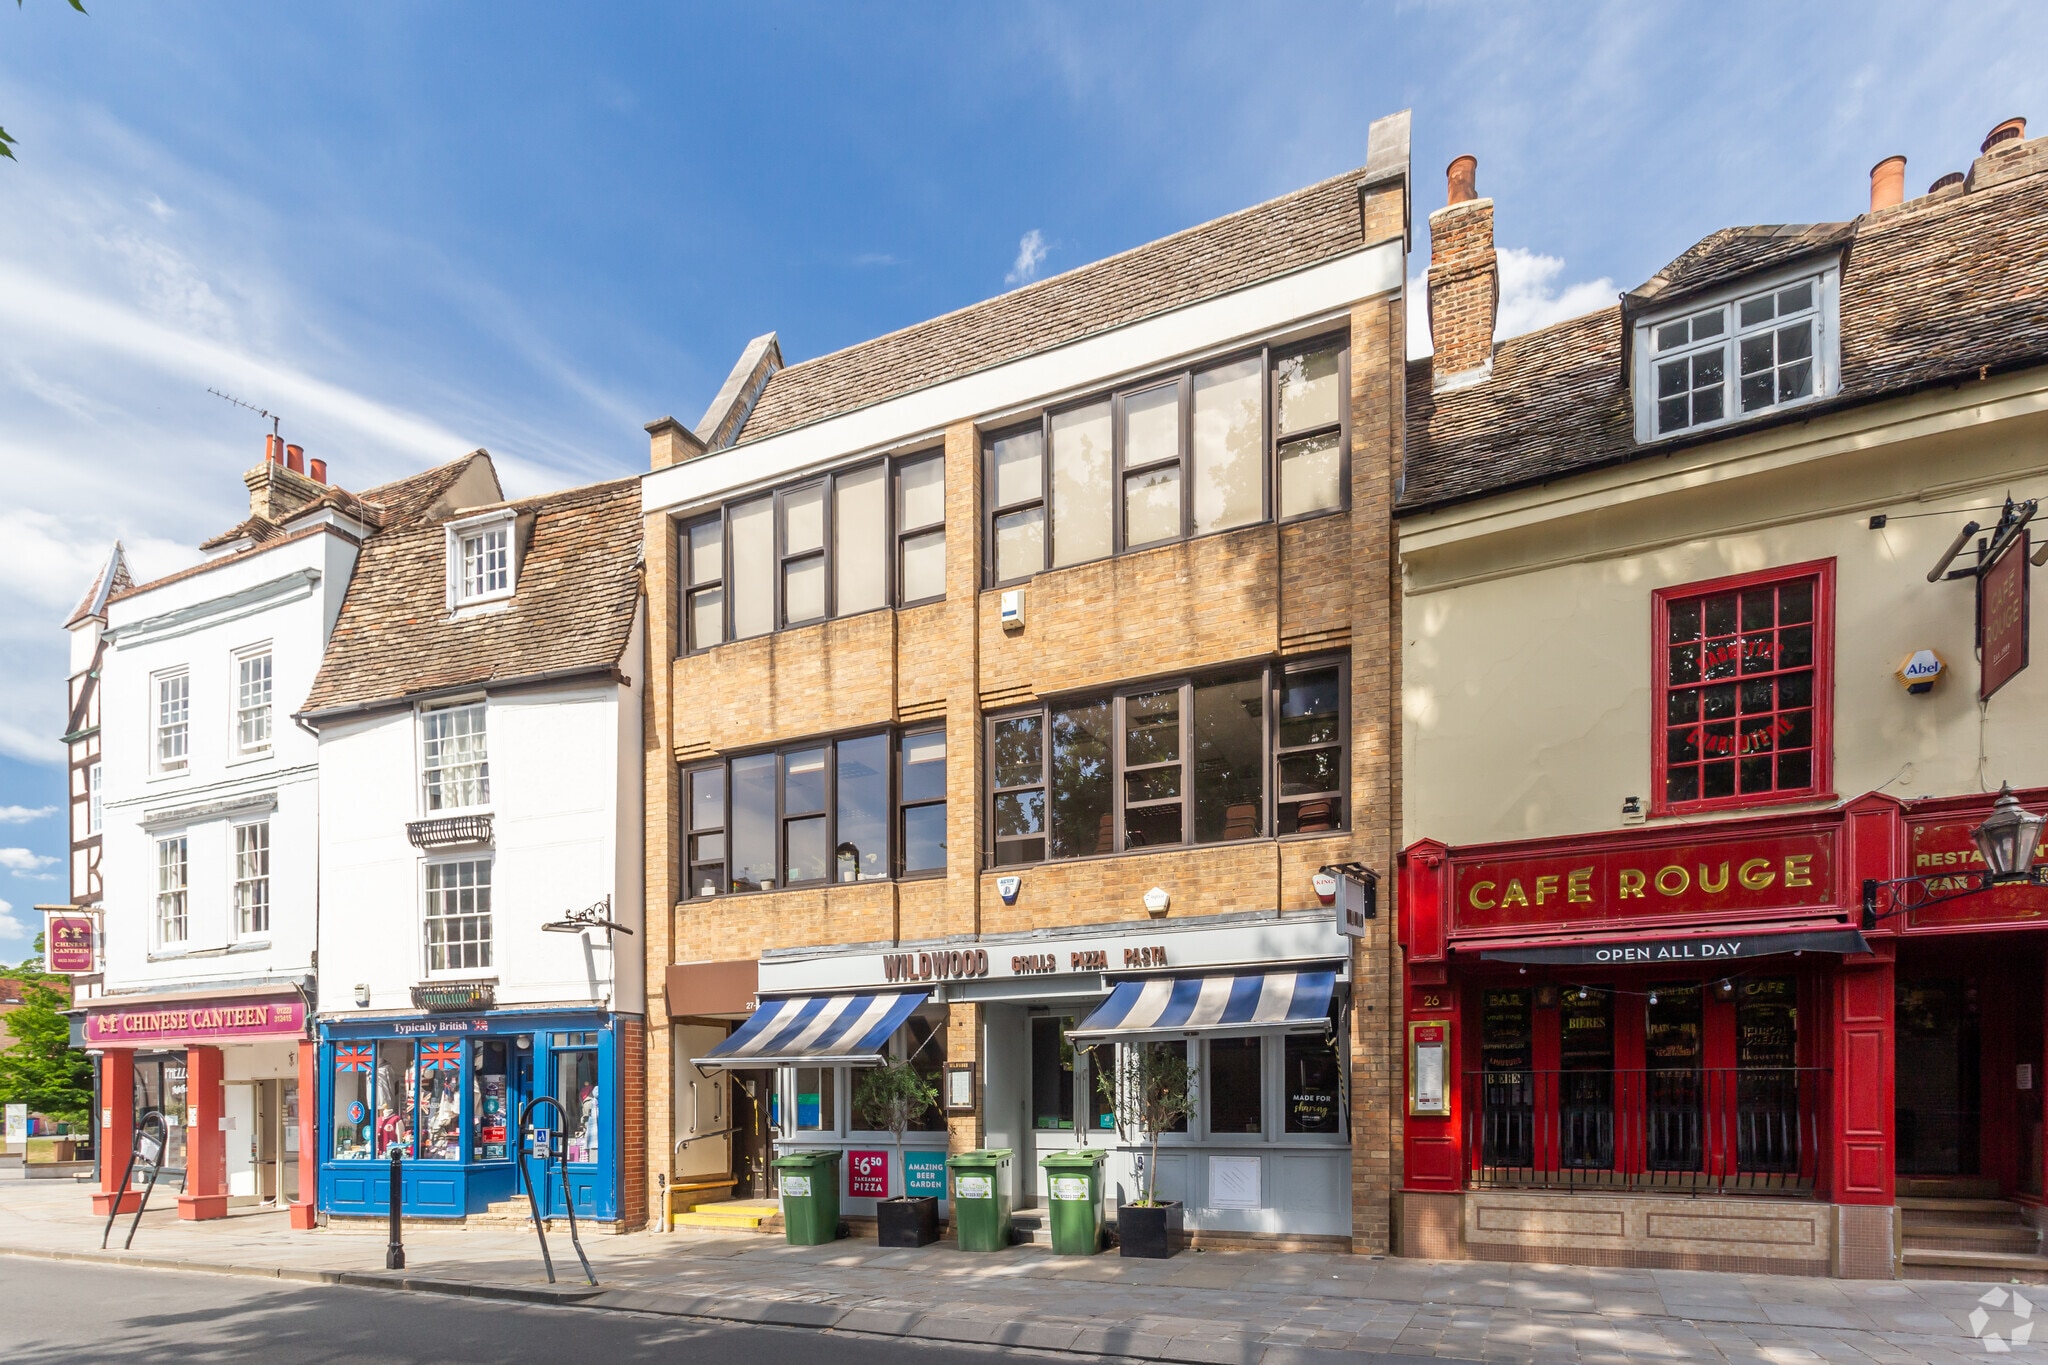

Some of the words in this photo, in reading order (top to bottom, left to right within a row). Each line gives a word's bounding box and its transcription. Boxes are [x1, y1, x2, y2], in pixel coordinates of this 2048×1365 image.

[1986, 598, 2019, 648] ROUGE
[1906, 661, 1939, 676] Abel
[1619, 853, 1814, 900] ROUGE
[1011, 953, 1056, 974] GRILLS
[1071, 950, 1109, 971] PIZZA
[1123, 946, 1168, 968] PASTA
[1595, 948, 1650, 962] OPEN
[1657, 945, 1695, 960] ALL
[1701, 942, 1741, 957] DAY
[883, 949, 989, 981] WILDWOOD
[1424, 996, 1440, 1007] 26
[123, 1012, 189, 1033] CHINESE
[191, 1006, 268, 1030] CANTEEN
[393, 1022, 437, 1034] Typically
[440, 1021, 467, 1031] British
[1294, 1101, 1329, 1118] sharing
[908, 1163, 944, 1171] AMAZING
[854, 1183, 883, 1192] PIZZA
